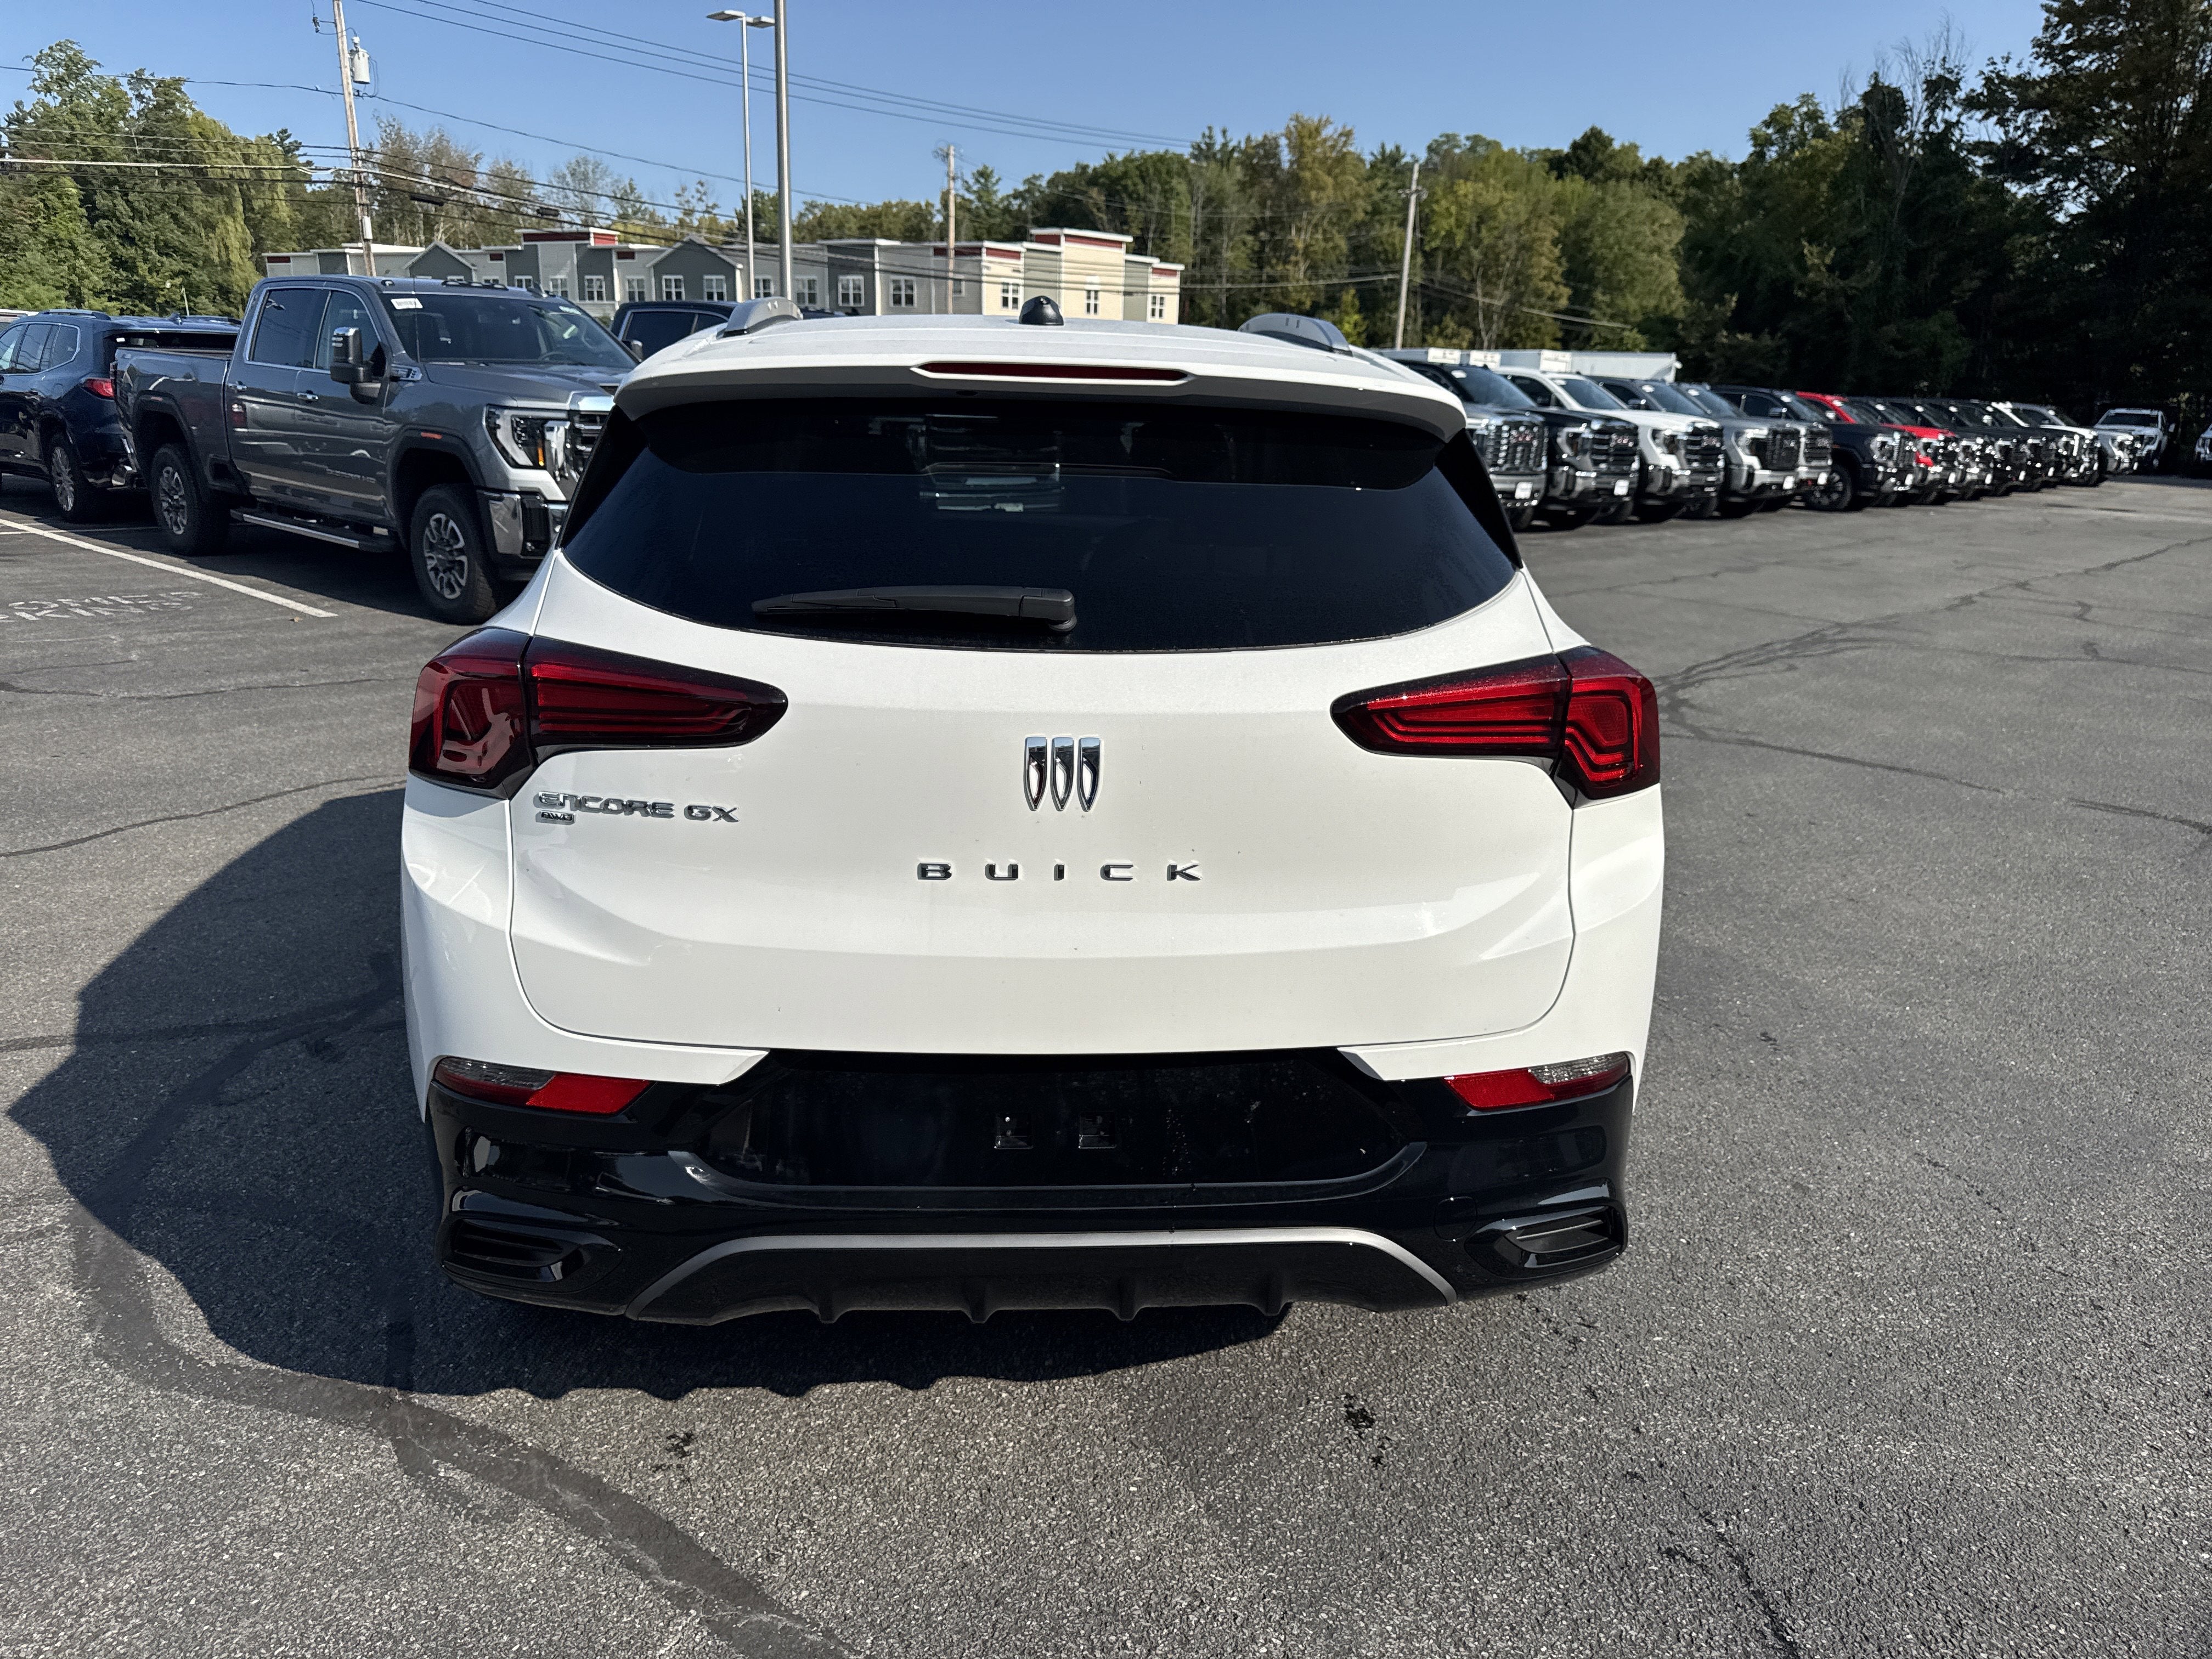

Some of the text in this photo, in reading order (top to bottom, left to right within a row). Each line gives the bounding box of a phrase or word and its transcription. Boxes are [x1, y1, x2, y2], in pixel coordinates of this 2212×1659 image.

[534, 791, 740, 822] ENCORE GX
[539, 811, 575, 822] AWD
[917, 862, 1203, 881] BUICK
